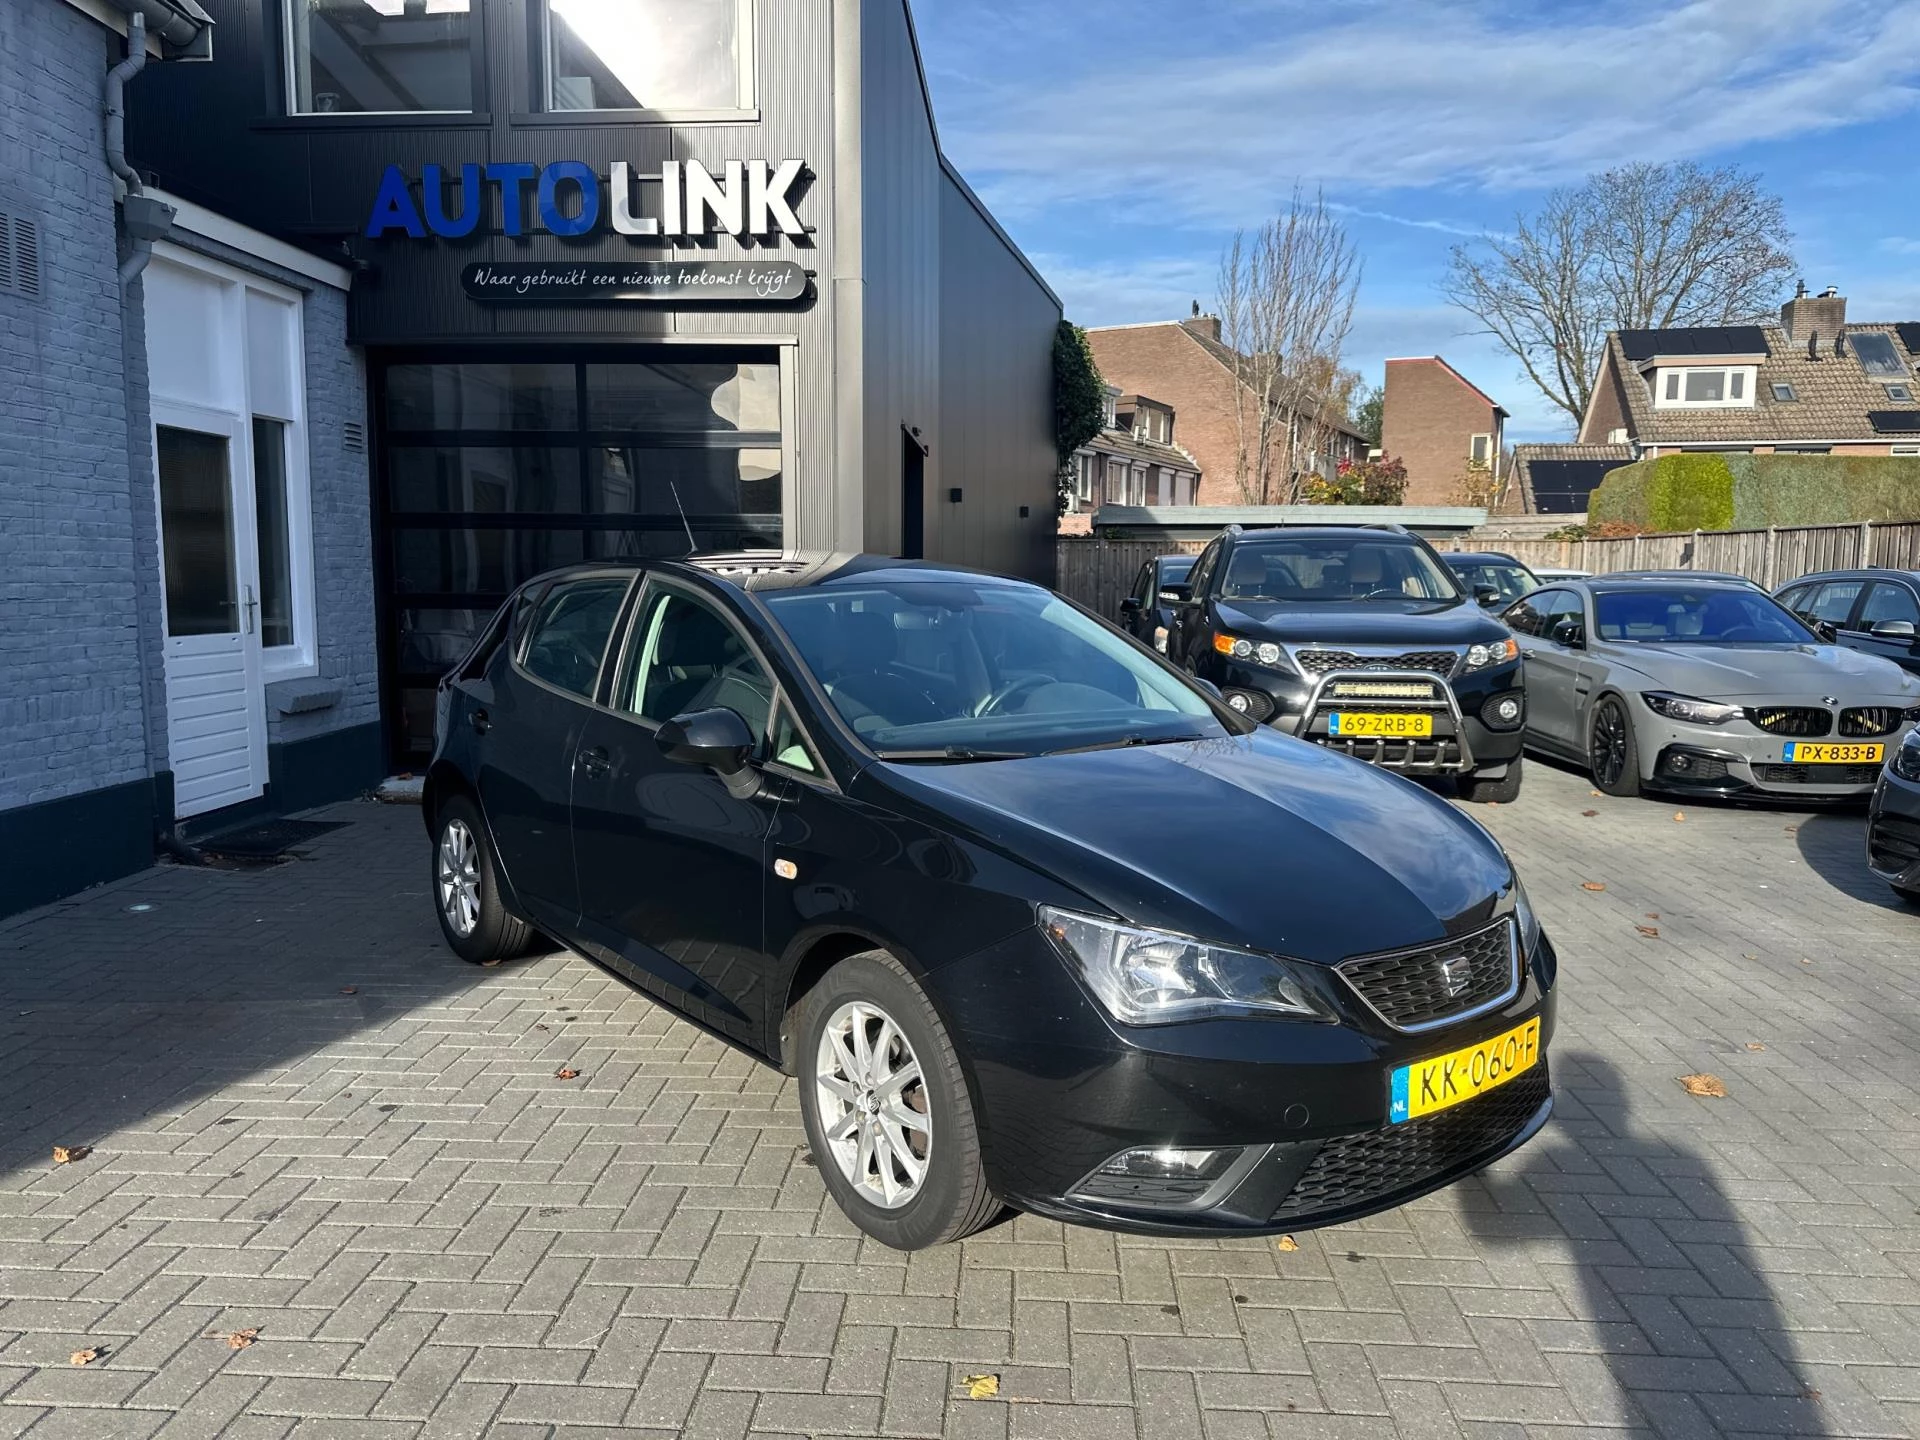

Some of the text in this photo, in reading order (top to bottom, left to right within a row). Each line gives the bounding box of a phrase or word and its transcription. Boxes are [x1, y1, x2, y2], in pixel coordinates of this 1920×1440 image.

[474, 267, 793, 296] Waar gebruikt een nieuwe toekomst krijgt
[1344, 717, 1424, 731] 69-ZRB-8
[1801, 746, 1876, 760] PX-833-B
[1421, 1025, 1535, 1106] KK-060-F
[1394, 1100, 1406, 1112] NL
